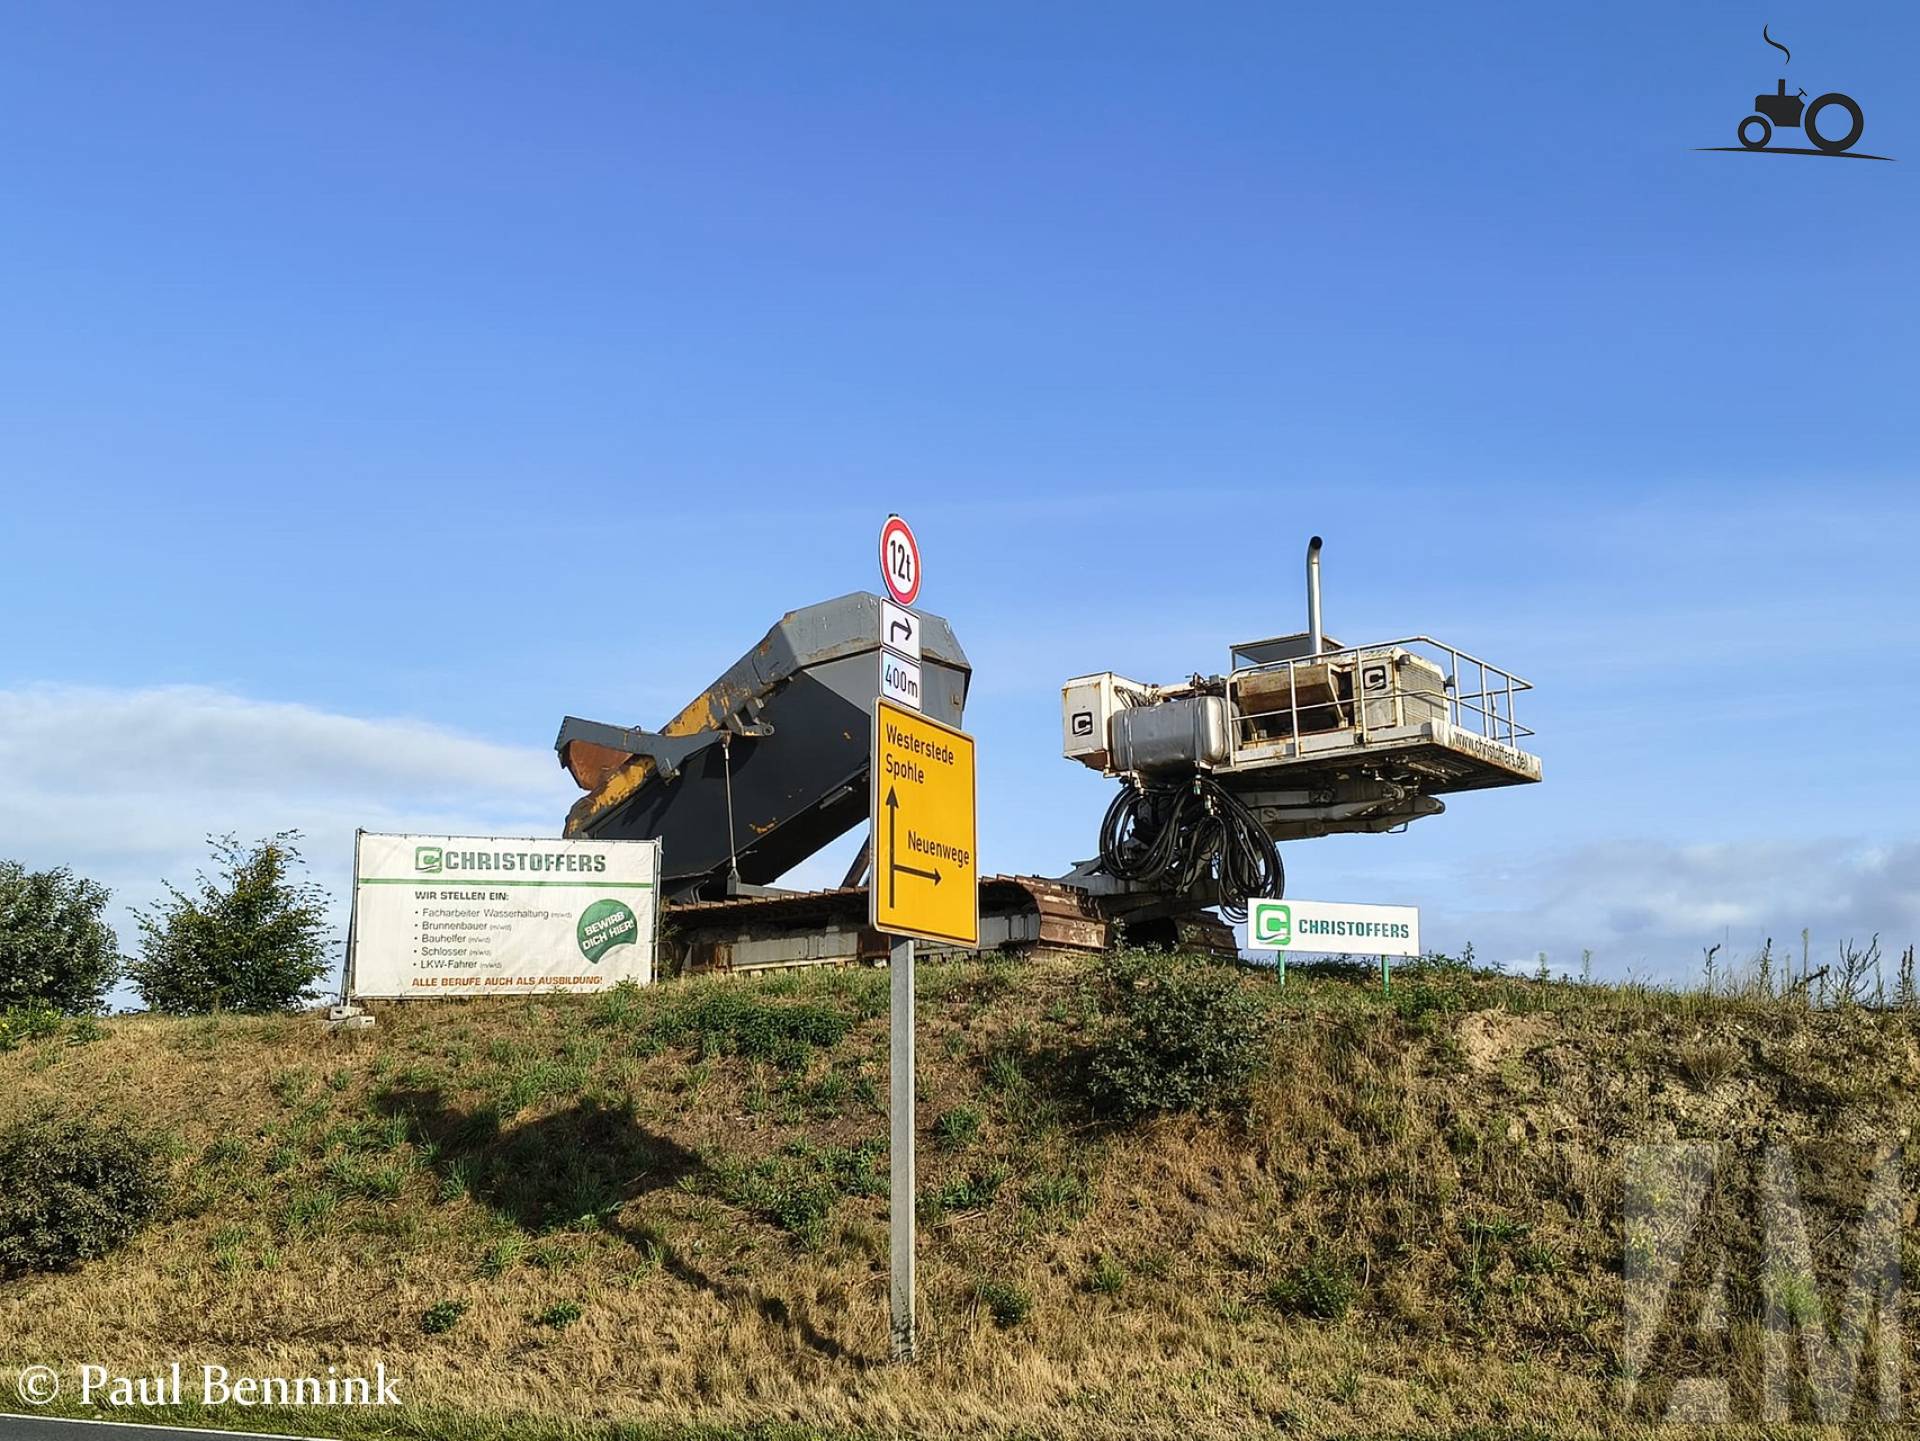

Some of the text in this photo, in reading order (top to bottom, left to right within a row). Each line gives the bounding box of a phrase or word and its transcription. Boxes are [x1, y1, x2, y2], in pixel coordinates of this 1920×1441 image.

[890, 540, 912, 582] 12t
[885, 664, 918, 698] 400m
[886, 723, 954, 765] Westerstede
[886, 754, 925, 784] Spohle
[908, 830, 970, 868] Neuenwege
[445, 851, 606, 872] CHRISTOFFERS
[415, 891, 510, 901] WIR STELLEN EIN:
[422, 908, 480, 918] Facharbeiter
[483, 909, 549, 919] Wasserhaltung
[584, 911, 625, 935] BEWIRB
[422, 921, 487, 931] Brunnenbauer
[582, 919, 635, 950] DICH HIER!
[1299, 919, 1409, 939] CHRISTOFFERS
[421, 934, 466, 943] Bauhelfer
[421, 947, 467, 956] Schlosser
[420, 960, 477, 969] LKW-Fahrer
[412, 976, 603, 987] ALLE BERUFE AUCH ALS AUSBILDUNG!
